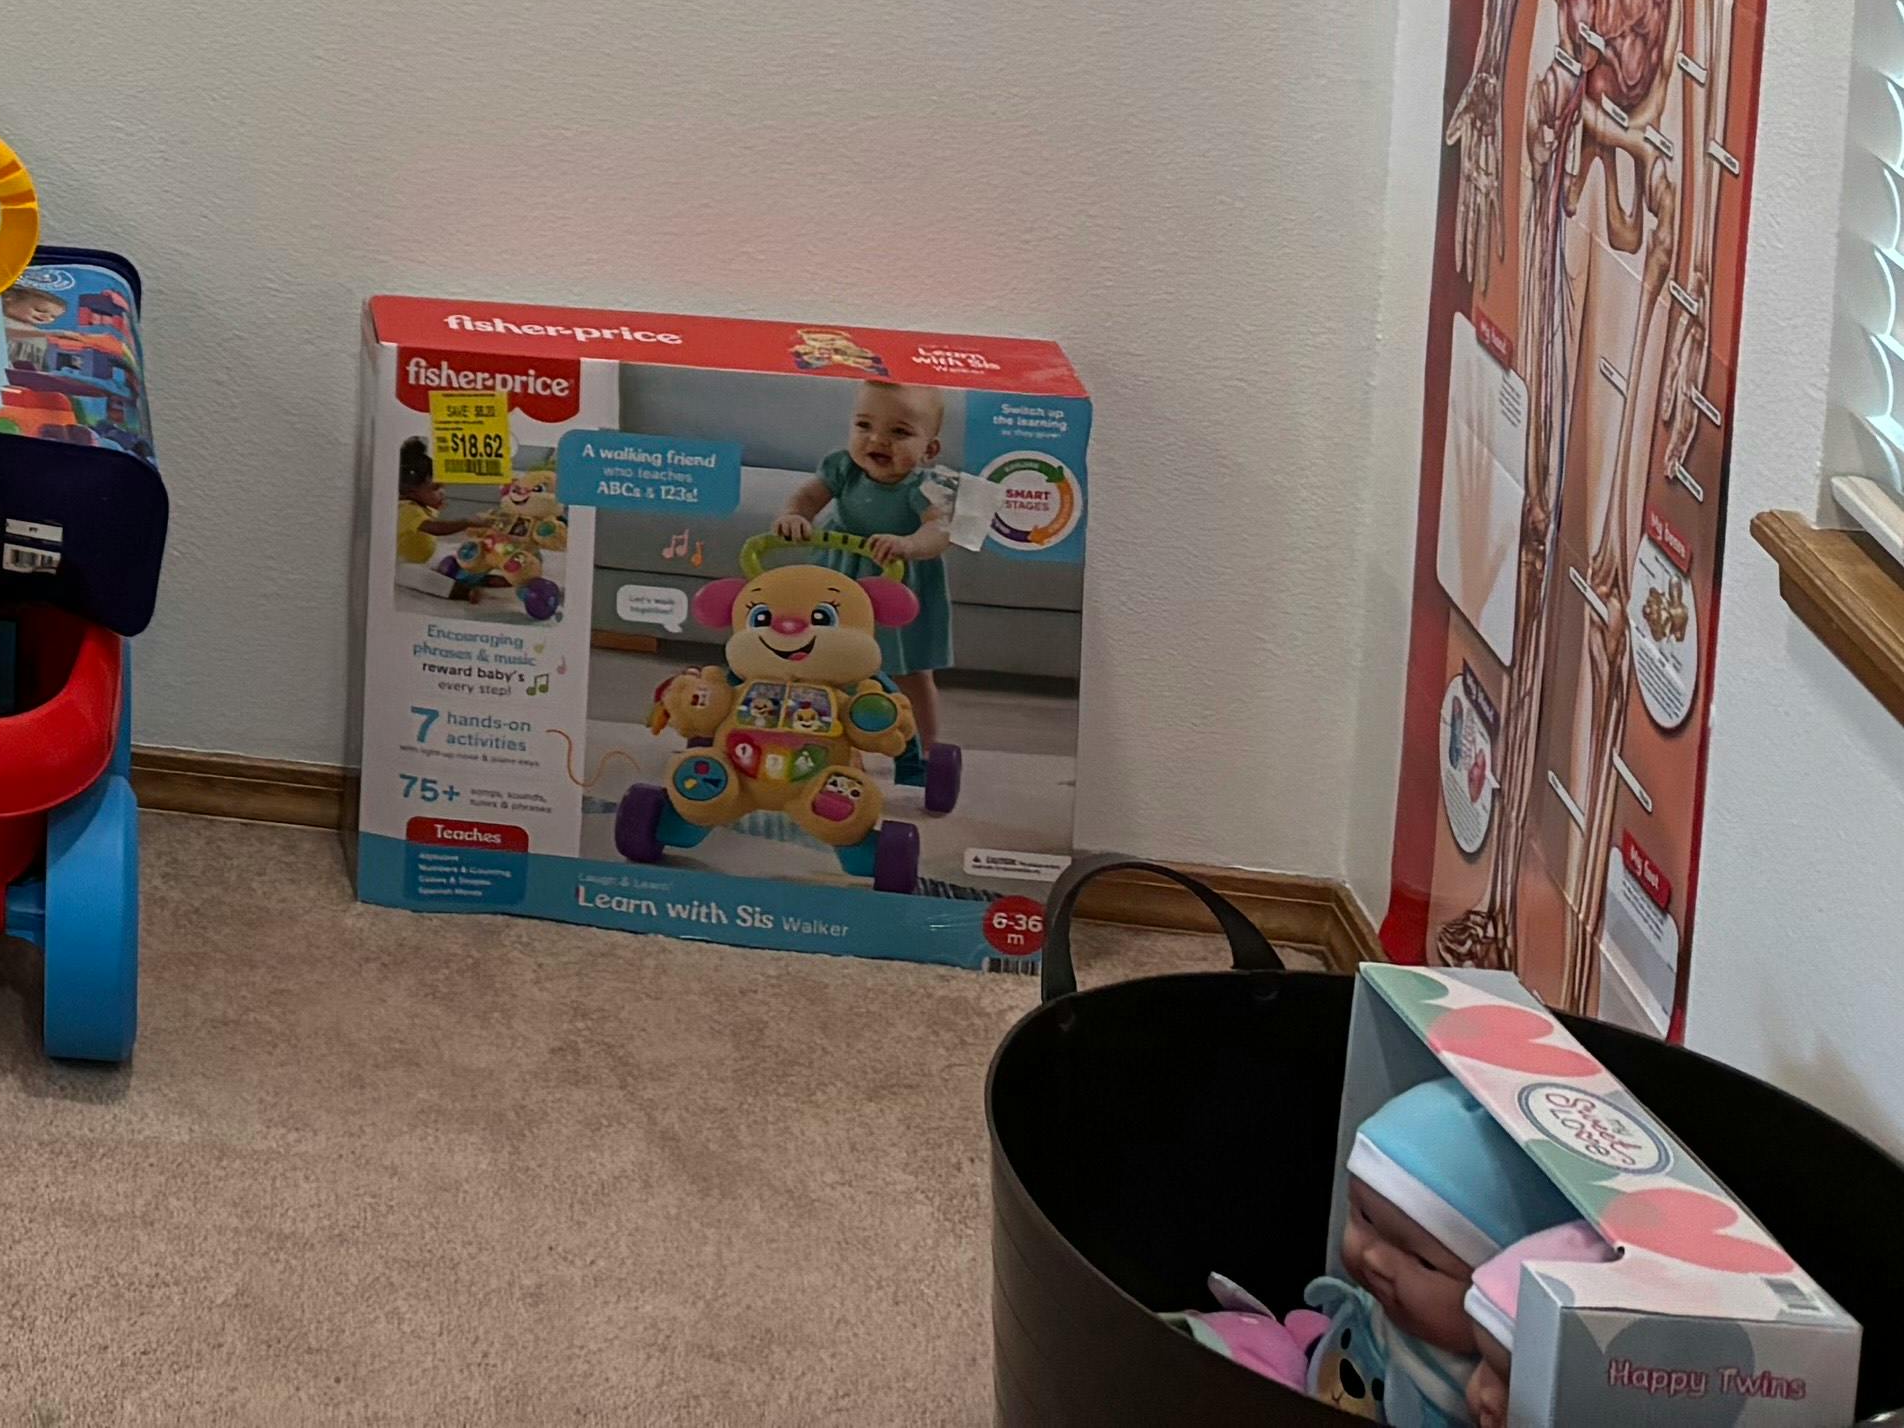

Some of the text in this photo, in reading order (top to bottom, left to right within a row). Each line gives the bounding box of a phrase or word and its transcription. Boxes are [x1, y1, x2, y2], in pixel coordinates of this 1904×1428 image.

[444, 314, 683, 345] fisher-price
[406, 357, 571, 396] fisher-price
[451, 433, 504, 459] $18.62
[582, 443, 718, 469] A walking friend
[1005, 489, 1050, 501] SMART
[427, 624, 524, 649] Encouraging
[413, 641, 472, 660] phrases
[494, 652, 536, 666] music
[422, 662, 525, 683] reward baby's
[438, 681, 474, 693] every
[410, 706, 532, 743] 7 hands-on
[446, 732, 527, 752] activities
[399, 773, 460, 803] 75+
[434, 823, 502, 844] Teaches
[577, 885, 849, 937] Learn with Sis Walker
[992, 912, 1044, 933] 6-36
[1007, 933, 1025, 945] m
[1608, 1358, 1807, 1400] Happy Twins
